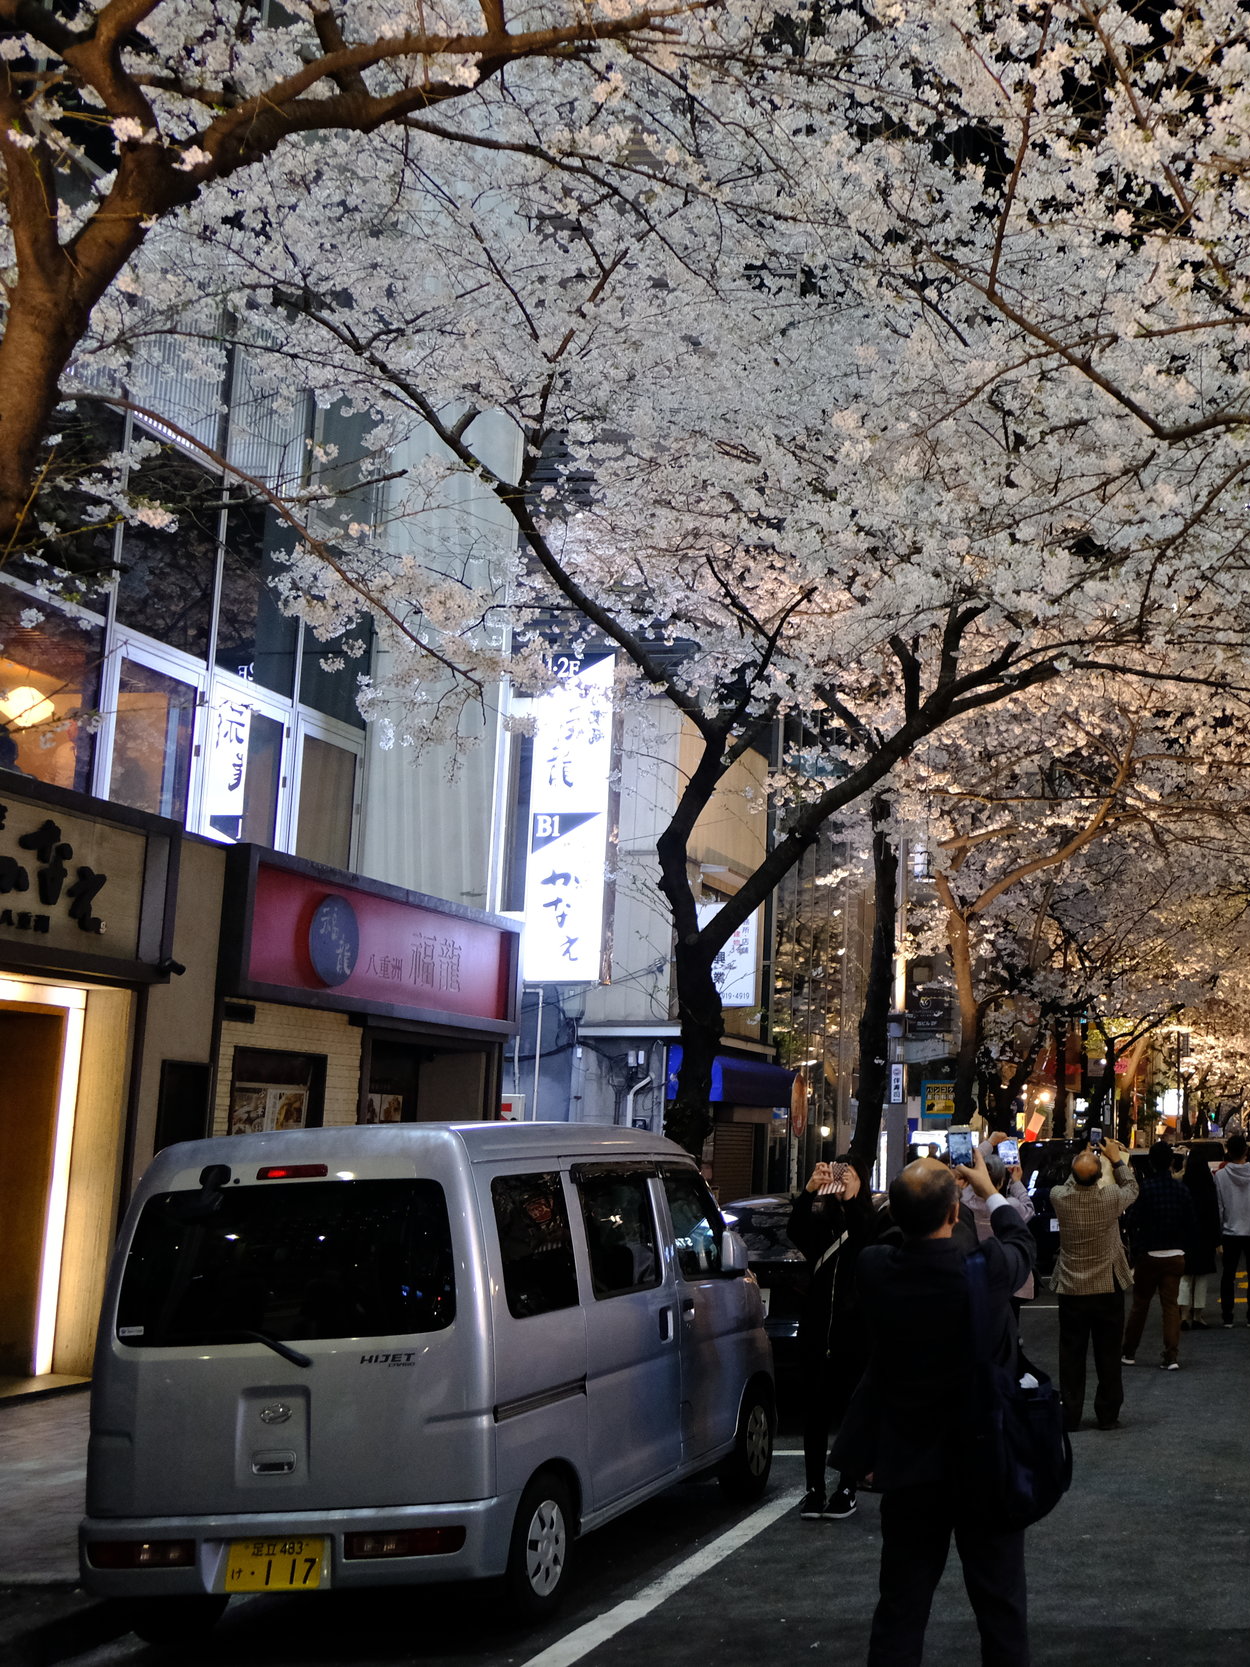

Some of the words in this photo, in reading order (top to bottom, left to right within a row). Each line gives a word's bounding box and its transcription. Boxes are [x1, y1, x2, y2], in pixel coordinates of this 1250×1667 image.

[536, 815, 560, 837] B1
[540, 870, 579, 961] かなえ
[366, 953, 403, 982] 八重洲
[409, 932, 462, 992] 福龍
[360, 1352, 416, 1365] HIJET
[280, 1541, 303, 1555] 483
[231, 1567, 243, 1580] け
